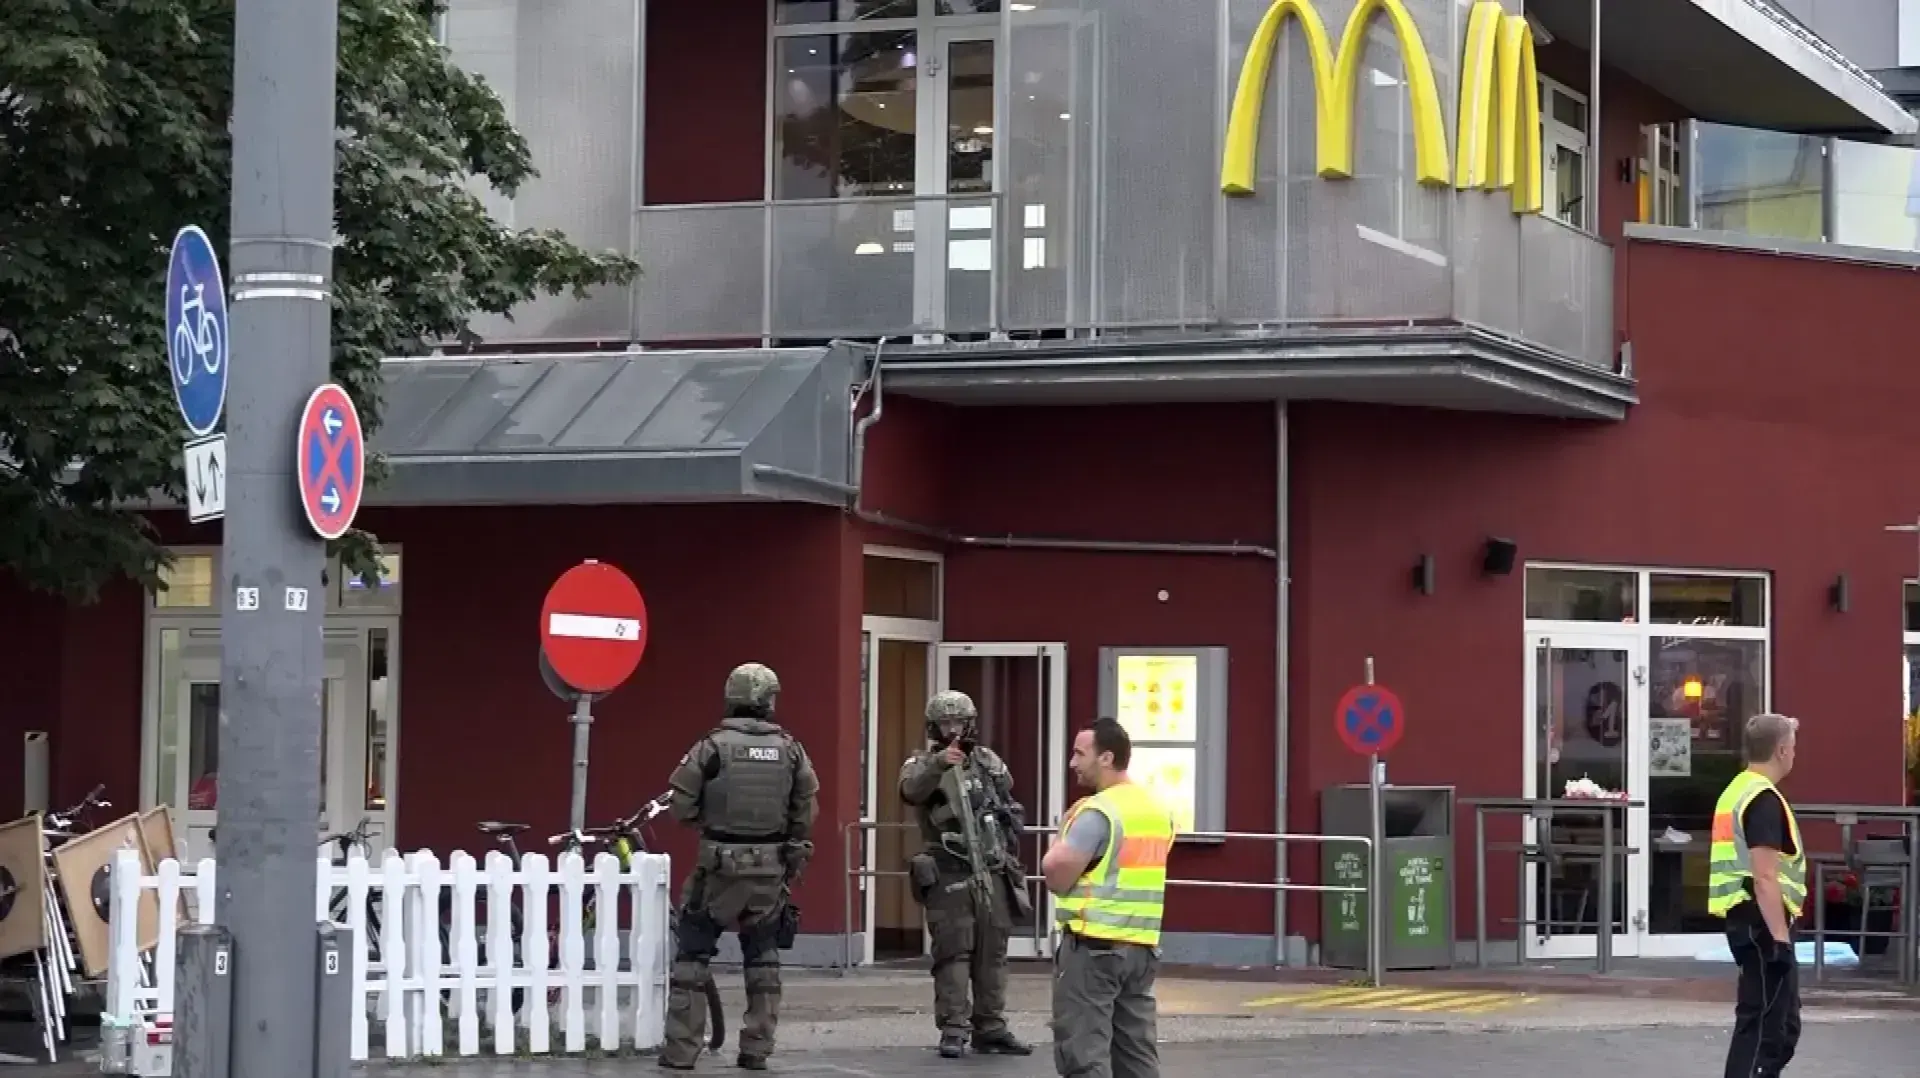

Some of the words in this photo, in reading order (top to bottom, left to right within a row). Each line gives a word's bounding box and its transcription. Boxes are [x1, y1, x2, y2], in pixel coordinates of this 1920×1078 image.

[748, 747, 780, 761] POLIZEI
[217, 955, 227, 971] 3
[328, 955, 337, 971] 3
